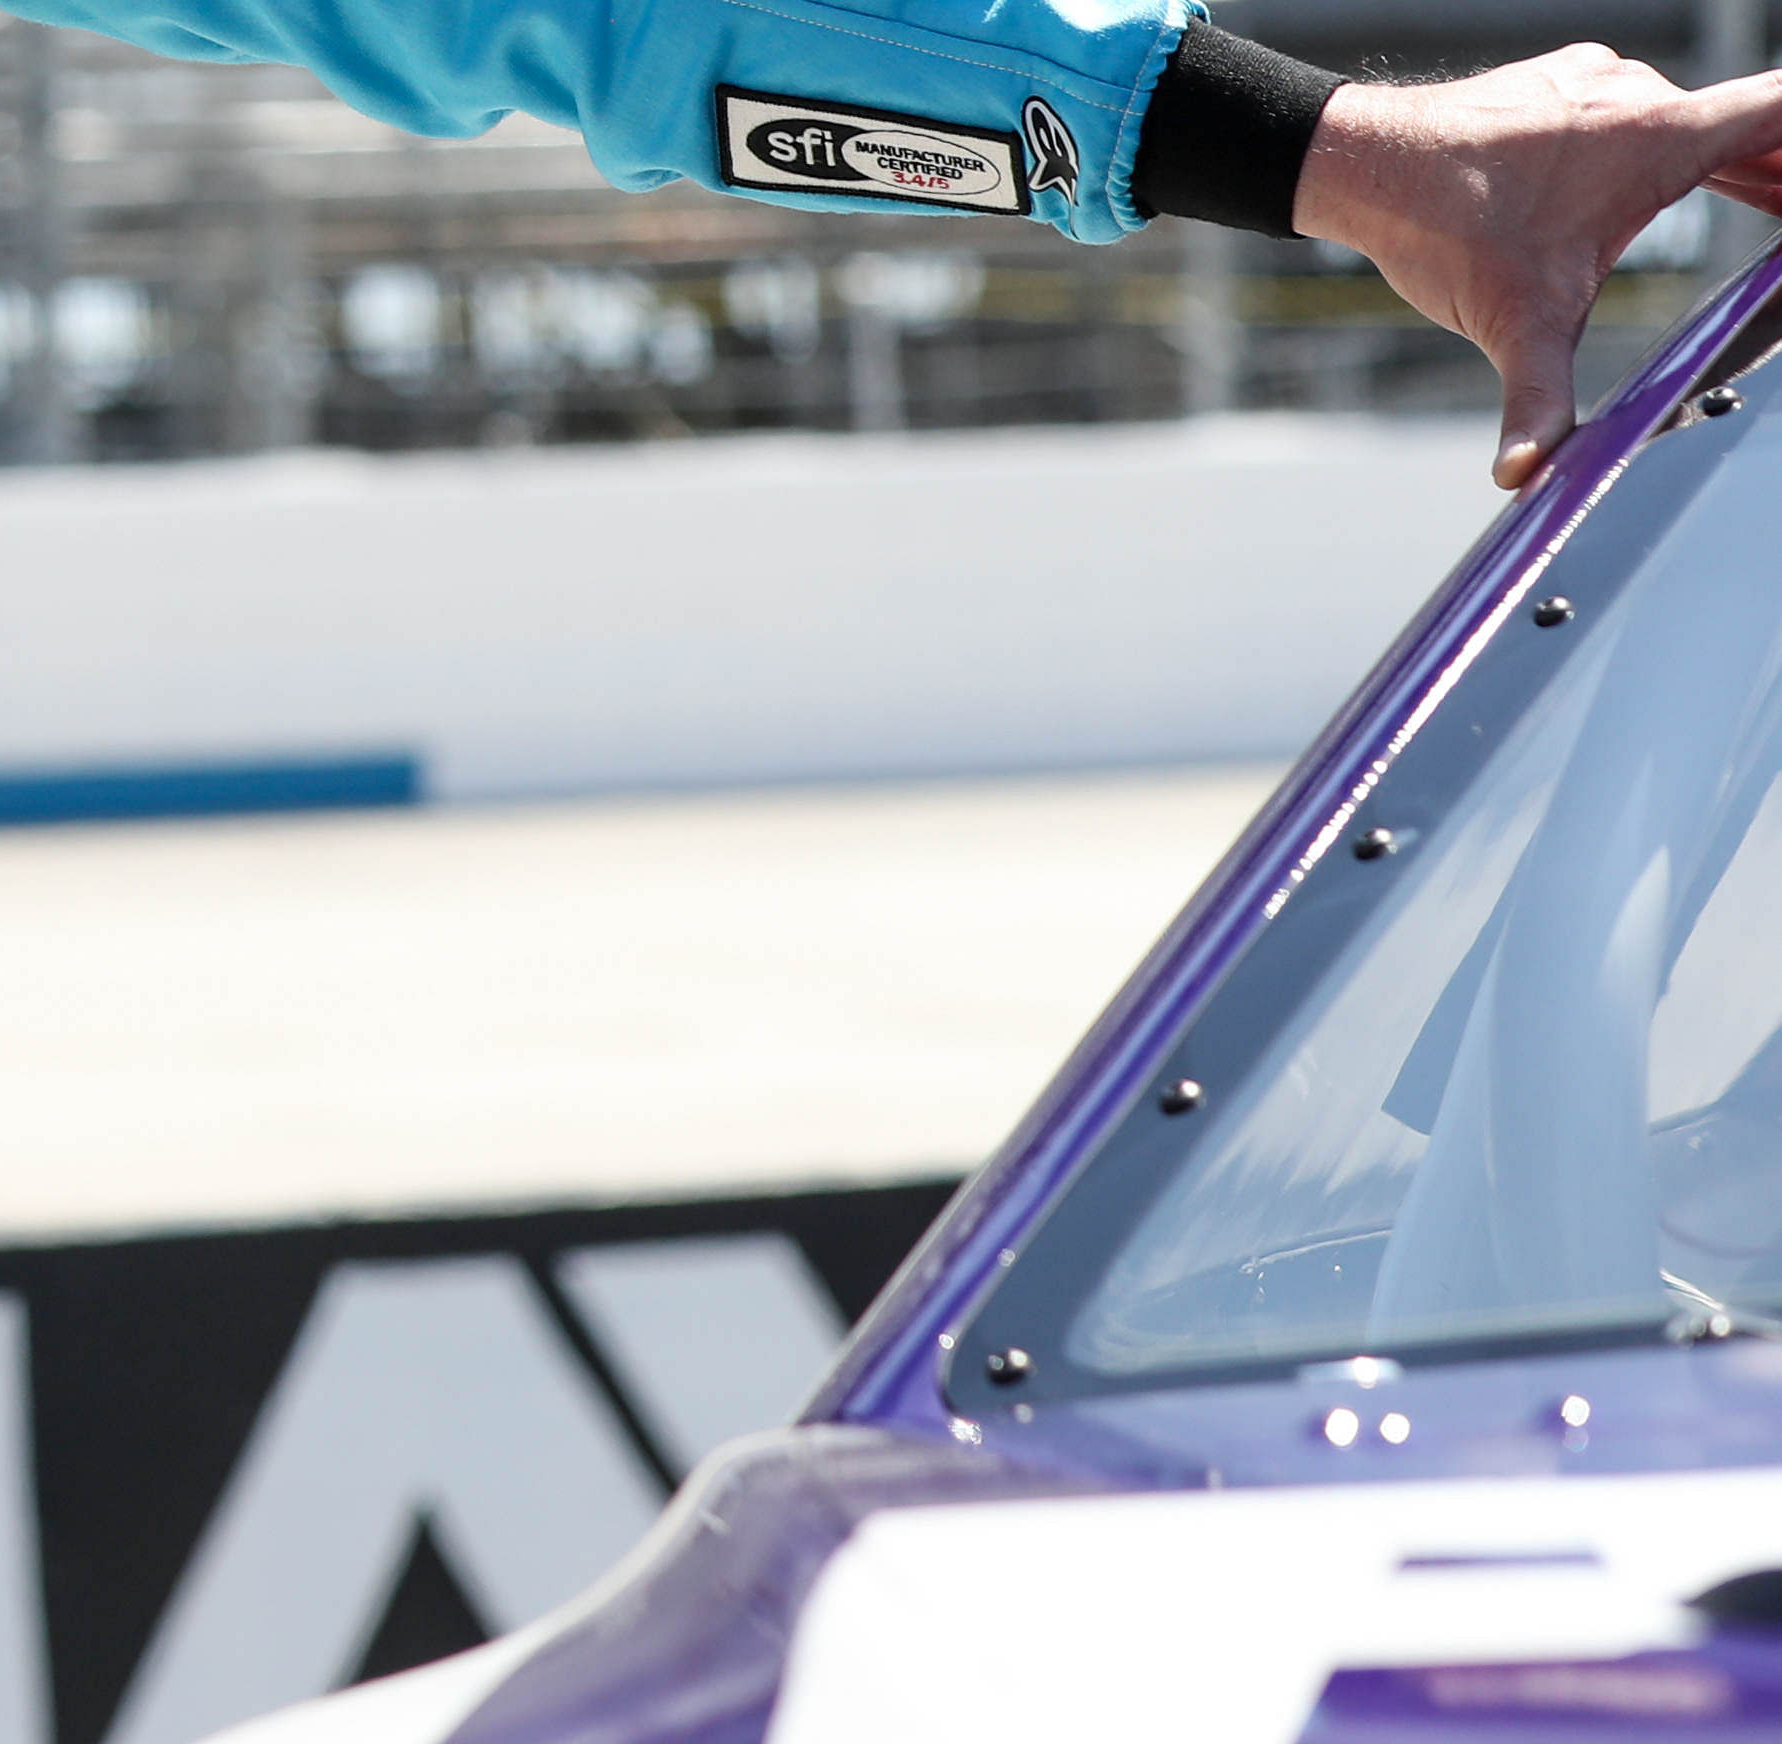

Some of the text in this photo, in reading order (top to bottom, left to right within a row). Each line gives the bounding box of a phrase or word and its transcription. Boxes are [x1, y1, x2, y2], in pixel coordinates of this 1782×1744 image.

[767, 127, 837, 168] sfi
[855, 140, 986, 173] MANUFACTURER
[877, 156, 964, 180] CERTIFIED
